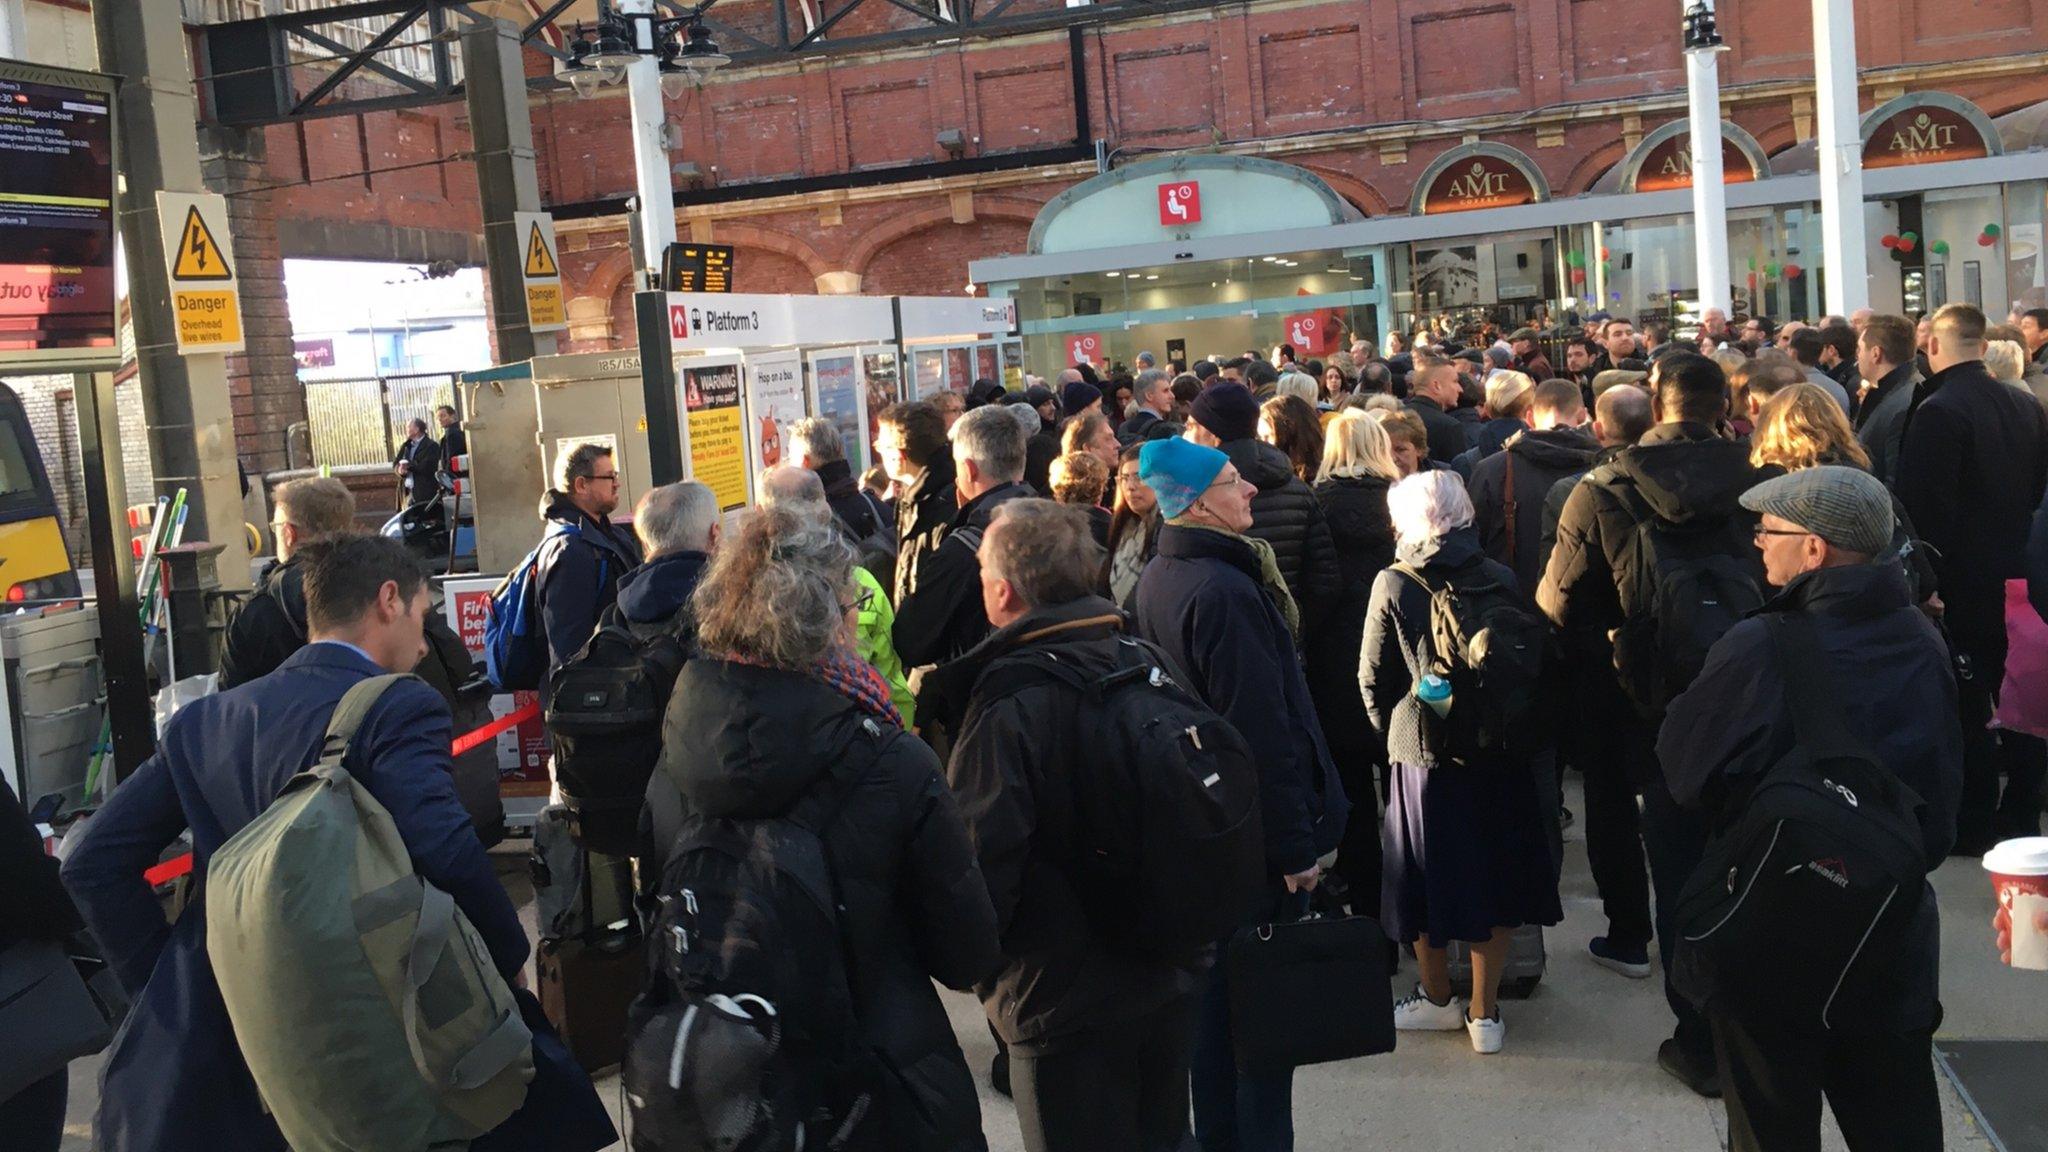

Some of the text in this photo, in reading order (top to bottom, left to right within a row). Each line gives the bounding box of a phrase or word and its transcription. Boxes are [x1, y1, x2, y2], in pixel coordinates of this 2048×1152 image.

[19, 107, 51, 120] Liverpool
[52, 112, 74, 121] Street
[1888, 124, 1959, 152] AMT
[1448, 172, 1510, 198] AMT
[528, 288, 556, 302] Danger
[177, 295, 228, 313] Danger
[181, 319, 223, 330] Overhead
[706, 310, 760, 331] Platform 3
[200, 332, 223, 341] wires
[700, 374, 737, 391] WARNING
[758, 370, 770, 385] Hop
[783, 368, 793, 381] bus
